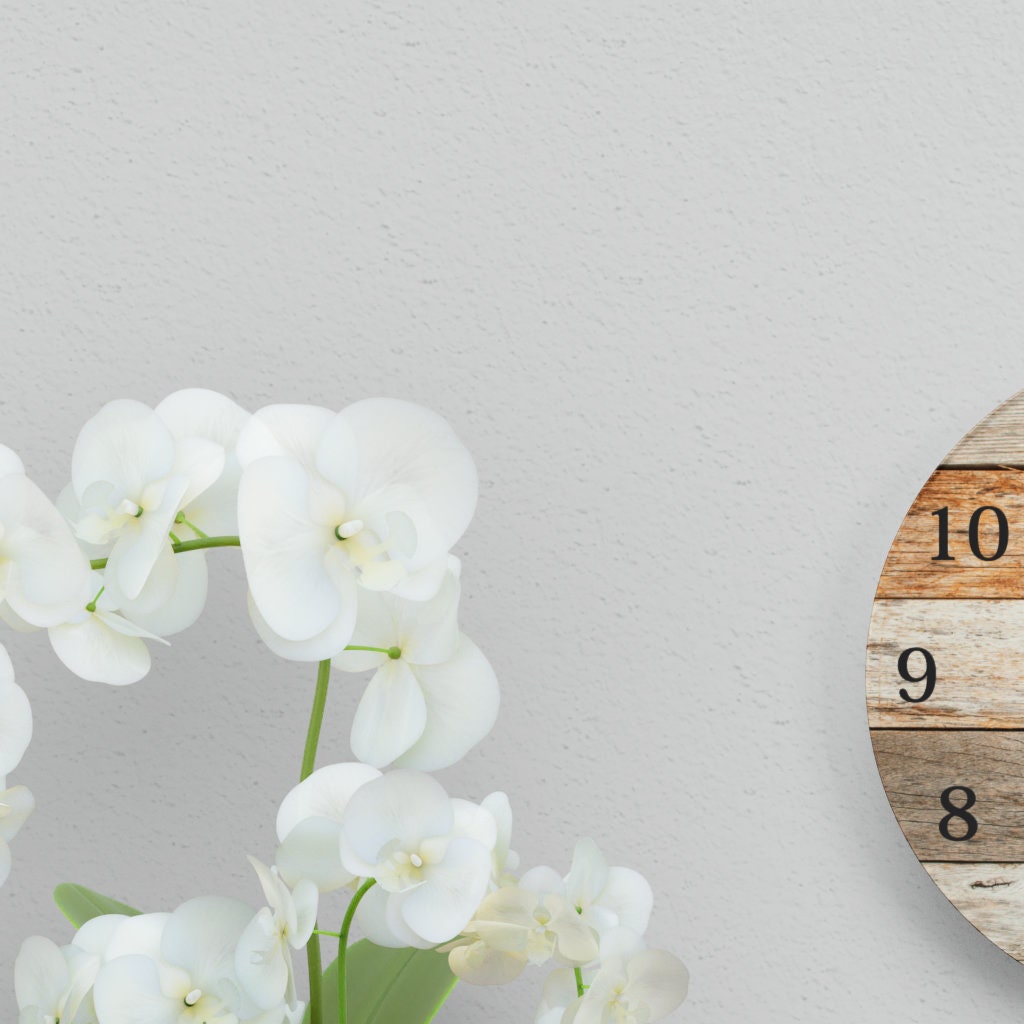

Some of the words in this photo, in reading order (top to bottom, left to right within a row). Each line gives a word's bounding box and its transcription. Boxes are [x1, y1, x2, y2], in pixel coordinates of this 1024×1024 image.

[931, 505, 1009, 562] 10
[897, 647, 937, 703] 9
[938, 785, 978, 842] 8
